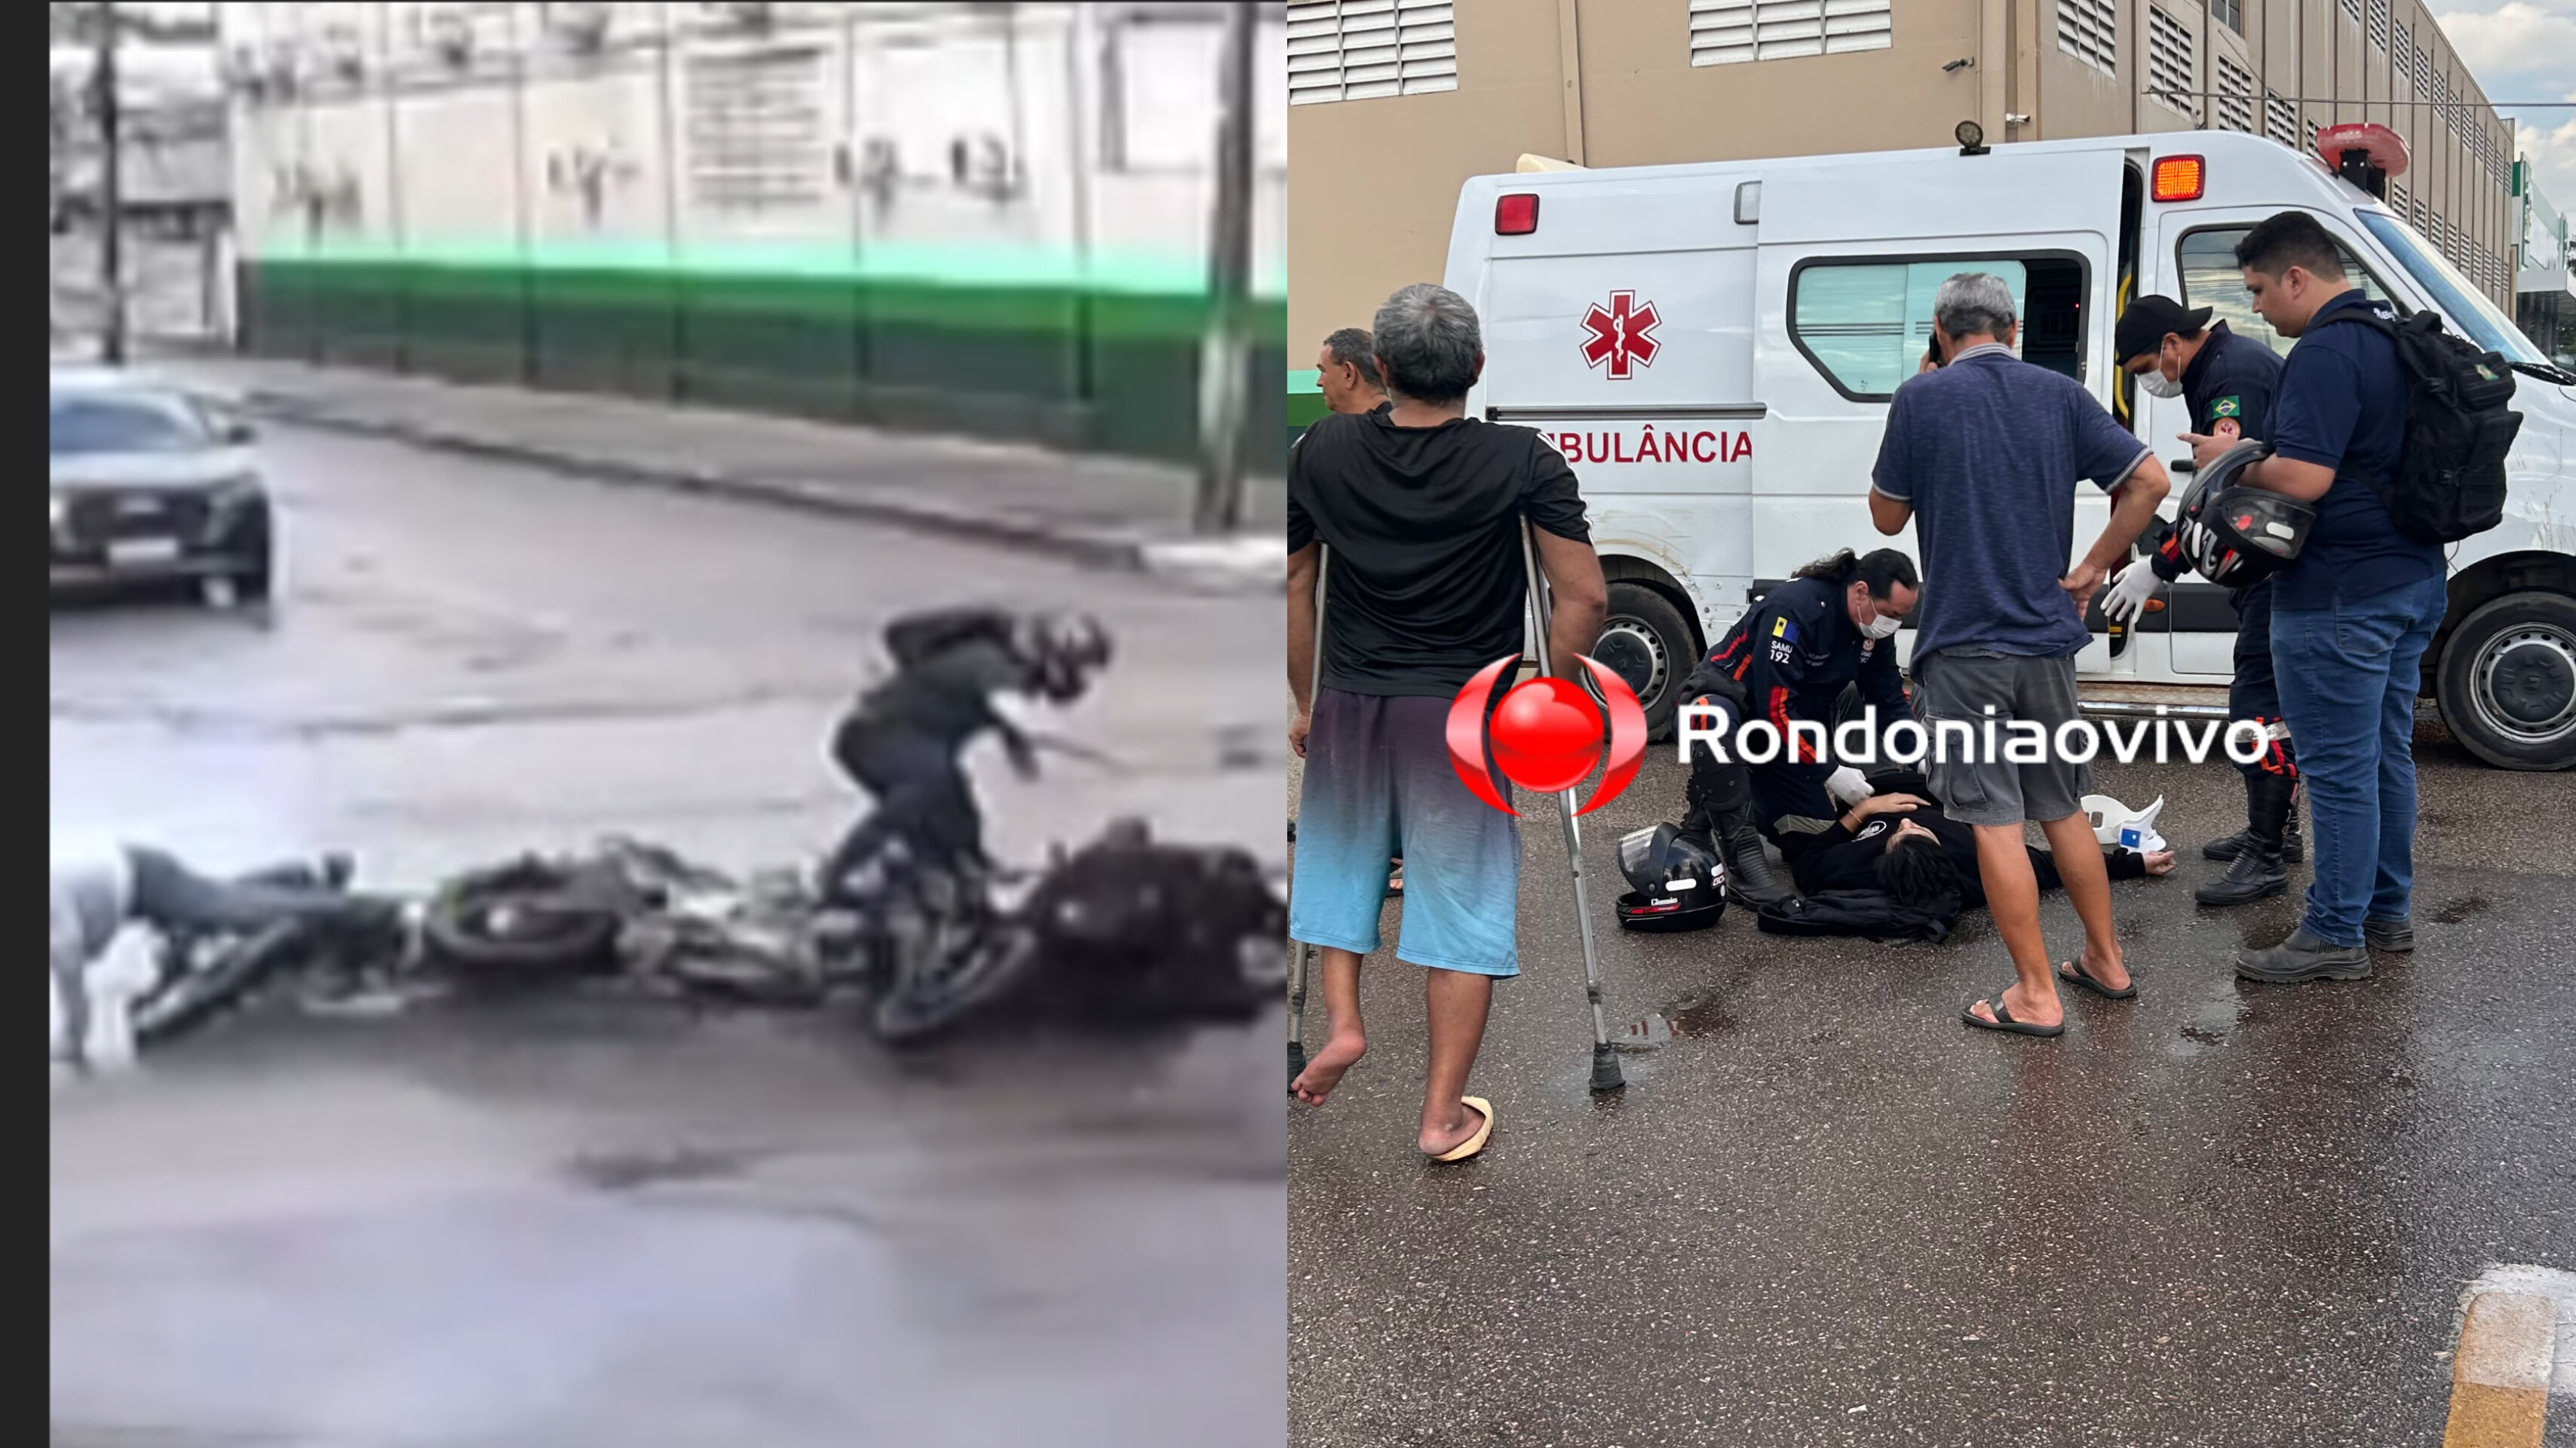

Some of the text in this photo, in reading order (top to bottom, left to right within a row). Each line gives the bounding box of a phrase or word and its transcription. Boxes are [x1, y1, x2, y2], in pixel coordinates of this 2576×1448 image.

[1546, 424, 1753, 463] BULÂNCIA
[1771, 640, 1793, 654] SAMU
[1770, 649, 1790, 664] 192
